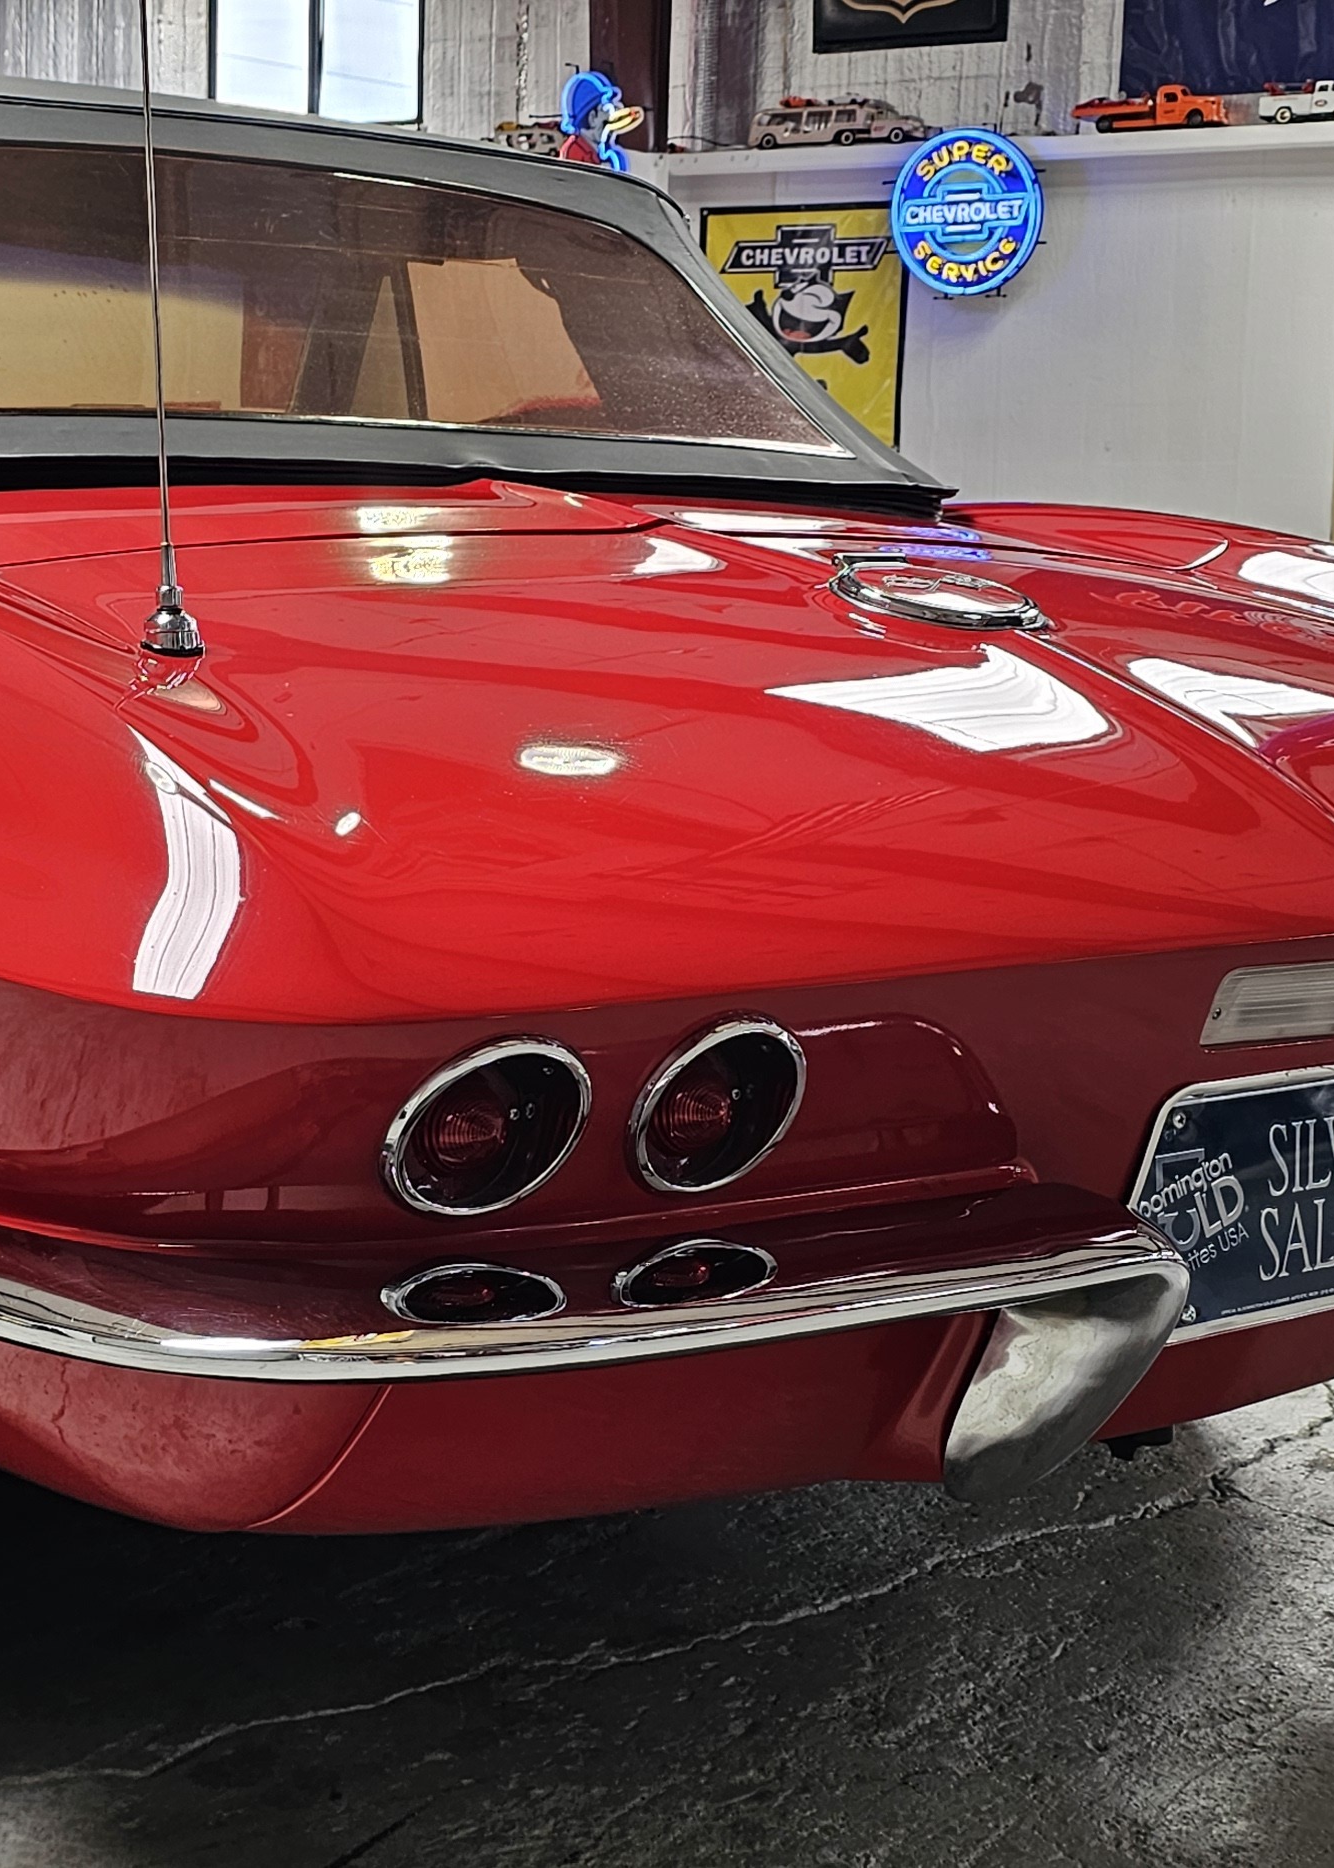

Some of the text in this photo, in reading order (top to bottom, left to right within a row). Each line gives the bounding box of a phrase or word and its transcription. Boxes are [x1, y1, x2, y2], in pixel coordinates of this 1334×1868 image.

[916, 140, 1012, 181] SUPER
[905, 200, 1023, 225] CHEVROLET
[740, 246, 871, 266] CHEVROLET
[914, 236, 1017, 283] SERVICE
[1139, 1153, 1233, 1218] oomington
[1218, 1222, 1249, 1251] USA
